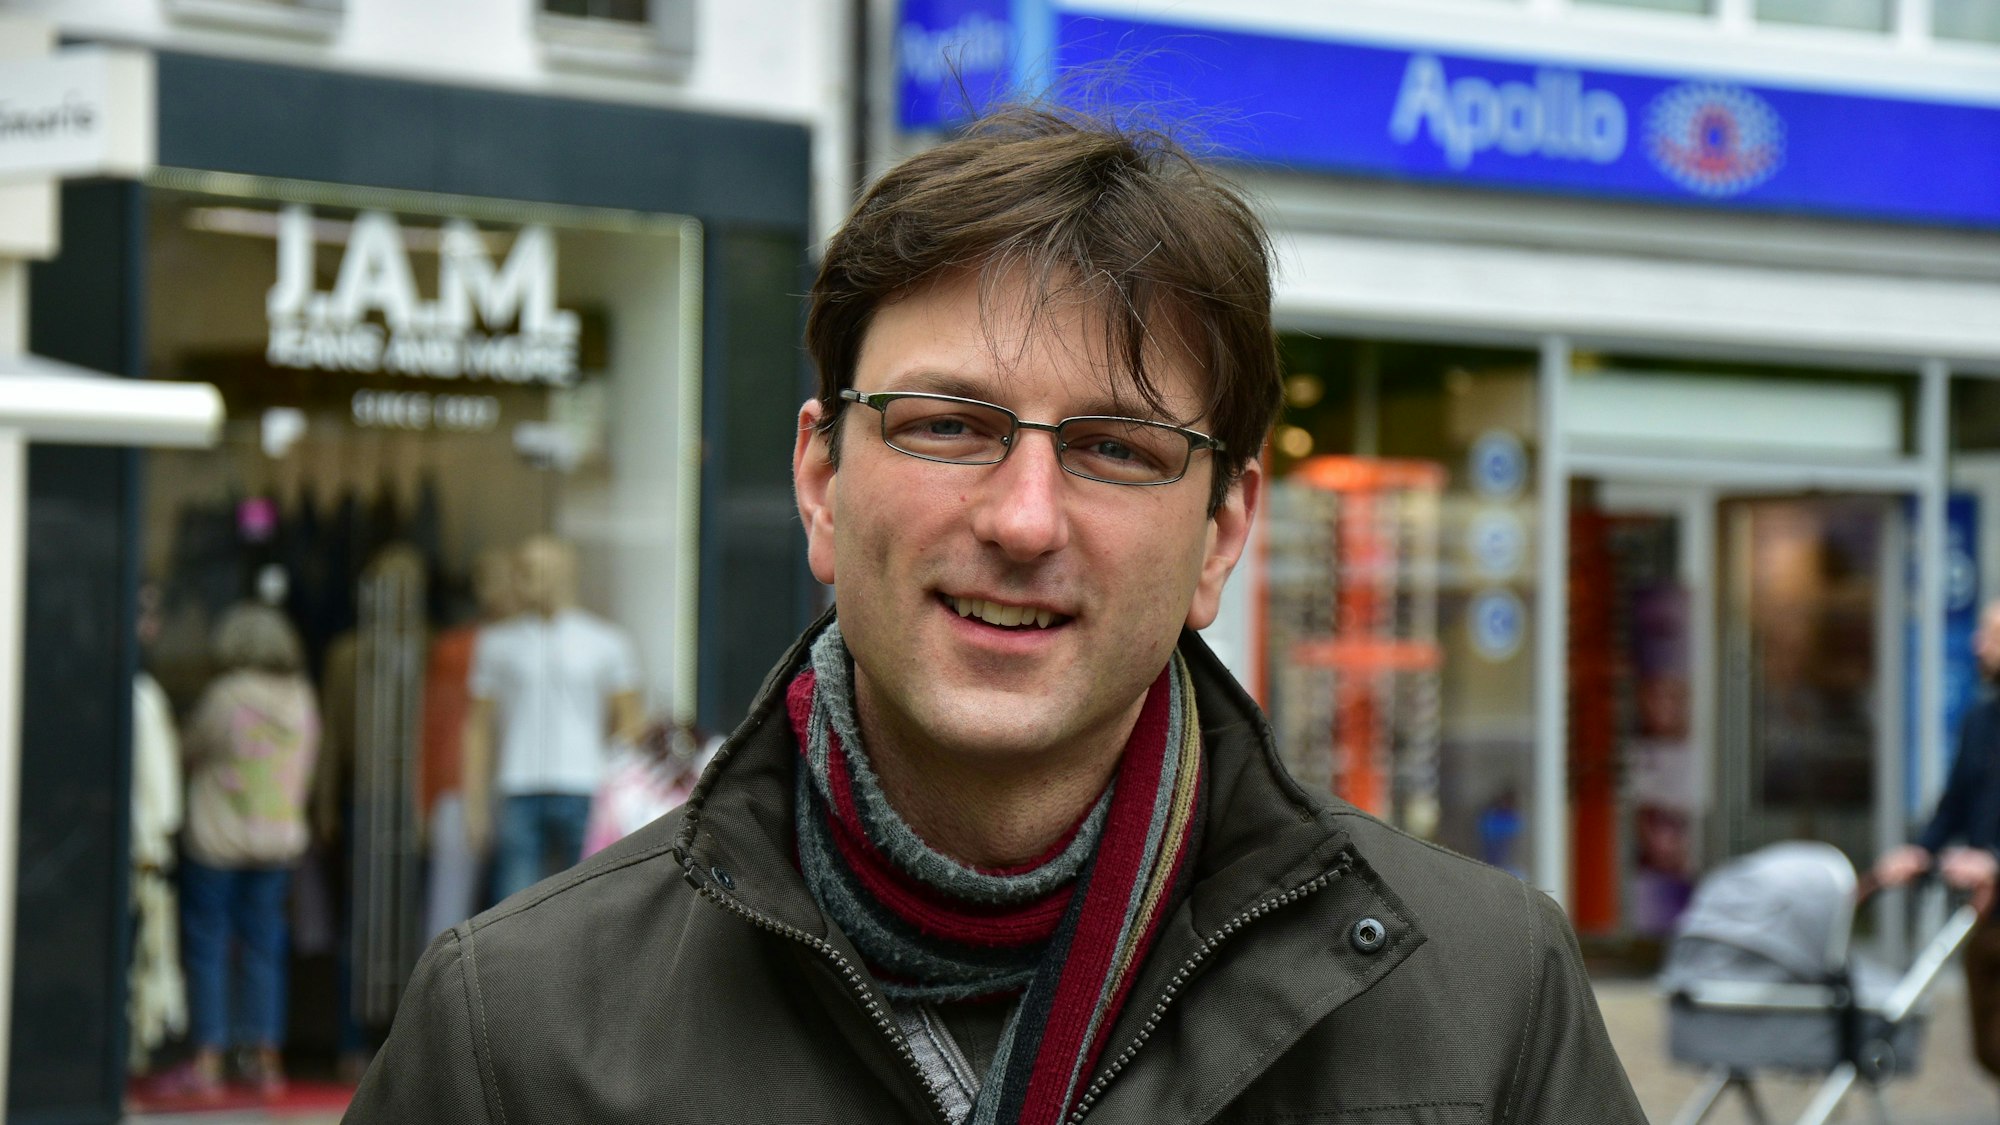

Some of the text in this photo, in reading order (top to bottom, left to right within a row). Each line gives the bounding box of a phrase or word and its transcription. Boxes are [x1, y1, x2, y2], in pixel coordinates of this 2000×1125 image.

[1389, 53, 1628, 171] Apollo
[266, 321, 581, 386] JEANS AND MORE
[352, 389, 432, 430] SINCE
